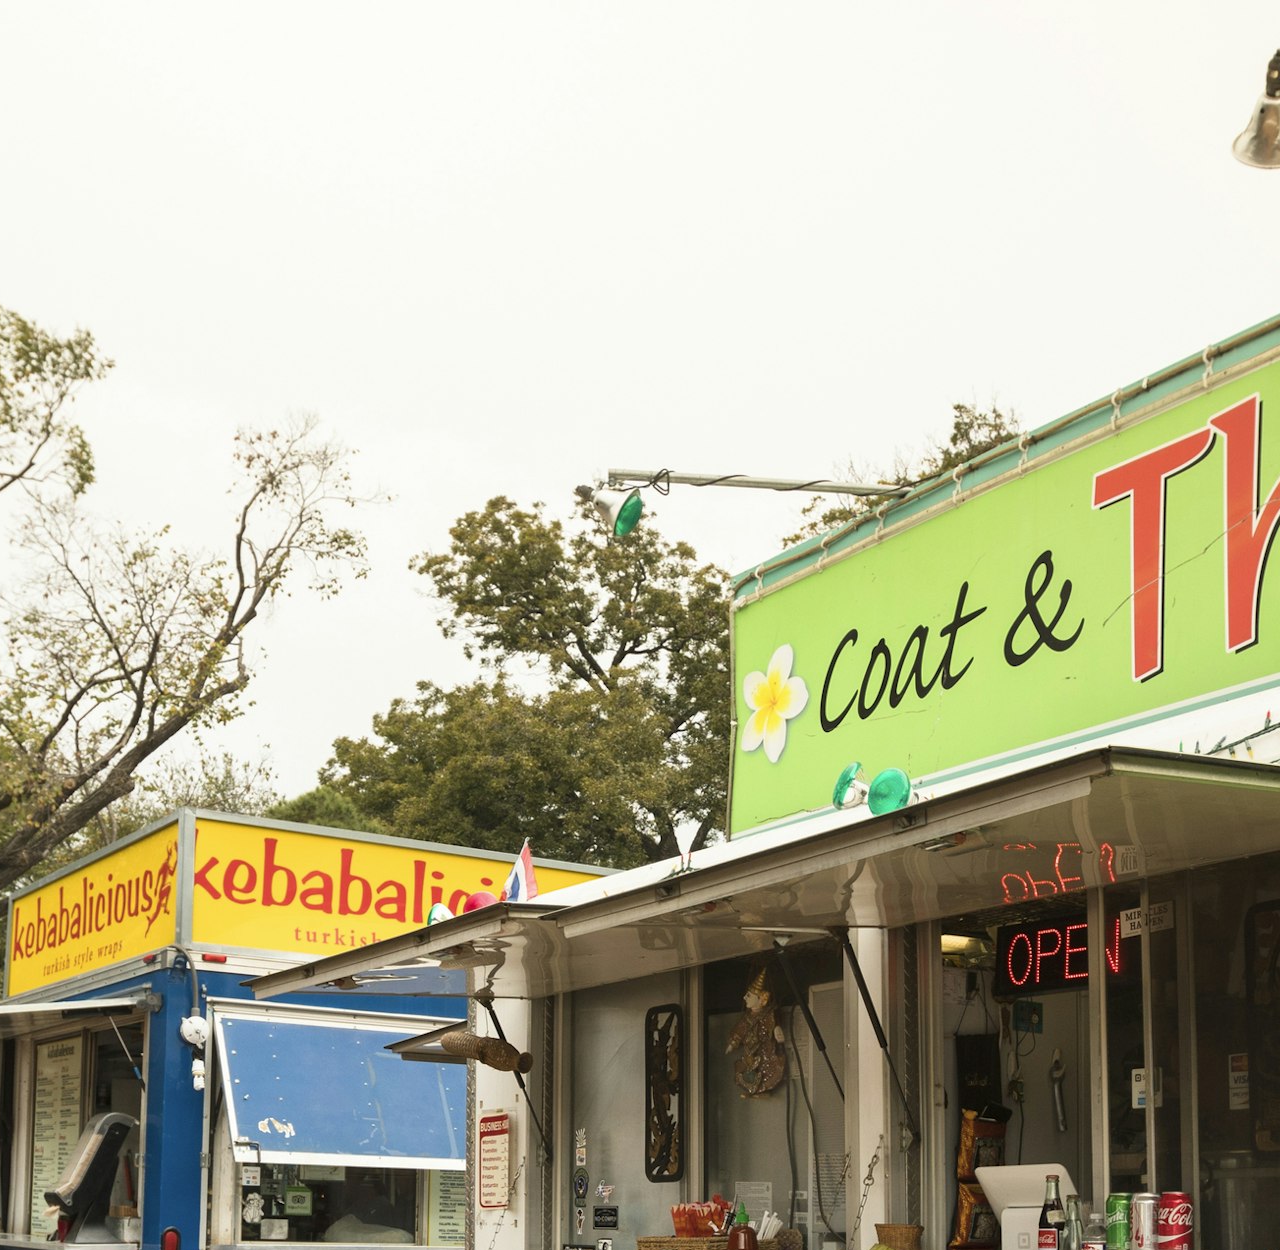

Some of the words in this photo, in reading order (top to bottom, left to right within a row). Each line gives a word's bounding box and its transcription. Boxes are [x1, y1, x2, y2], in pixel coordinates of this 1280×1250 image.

[819, 582, 987, 734] Coat
[1003, 549, 1084, 668] &
[13, 870, 153, 961] kebabalicious
[1125, 905, 1169, 921] MIRCLES
